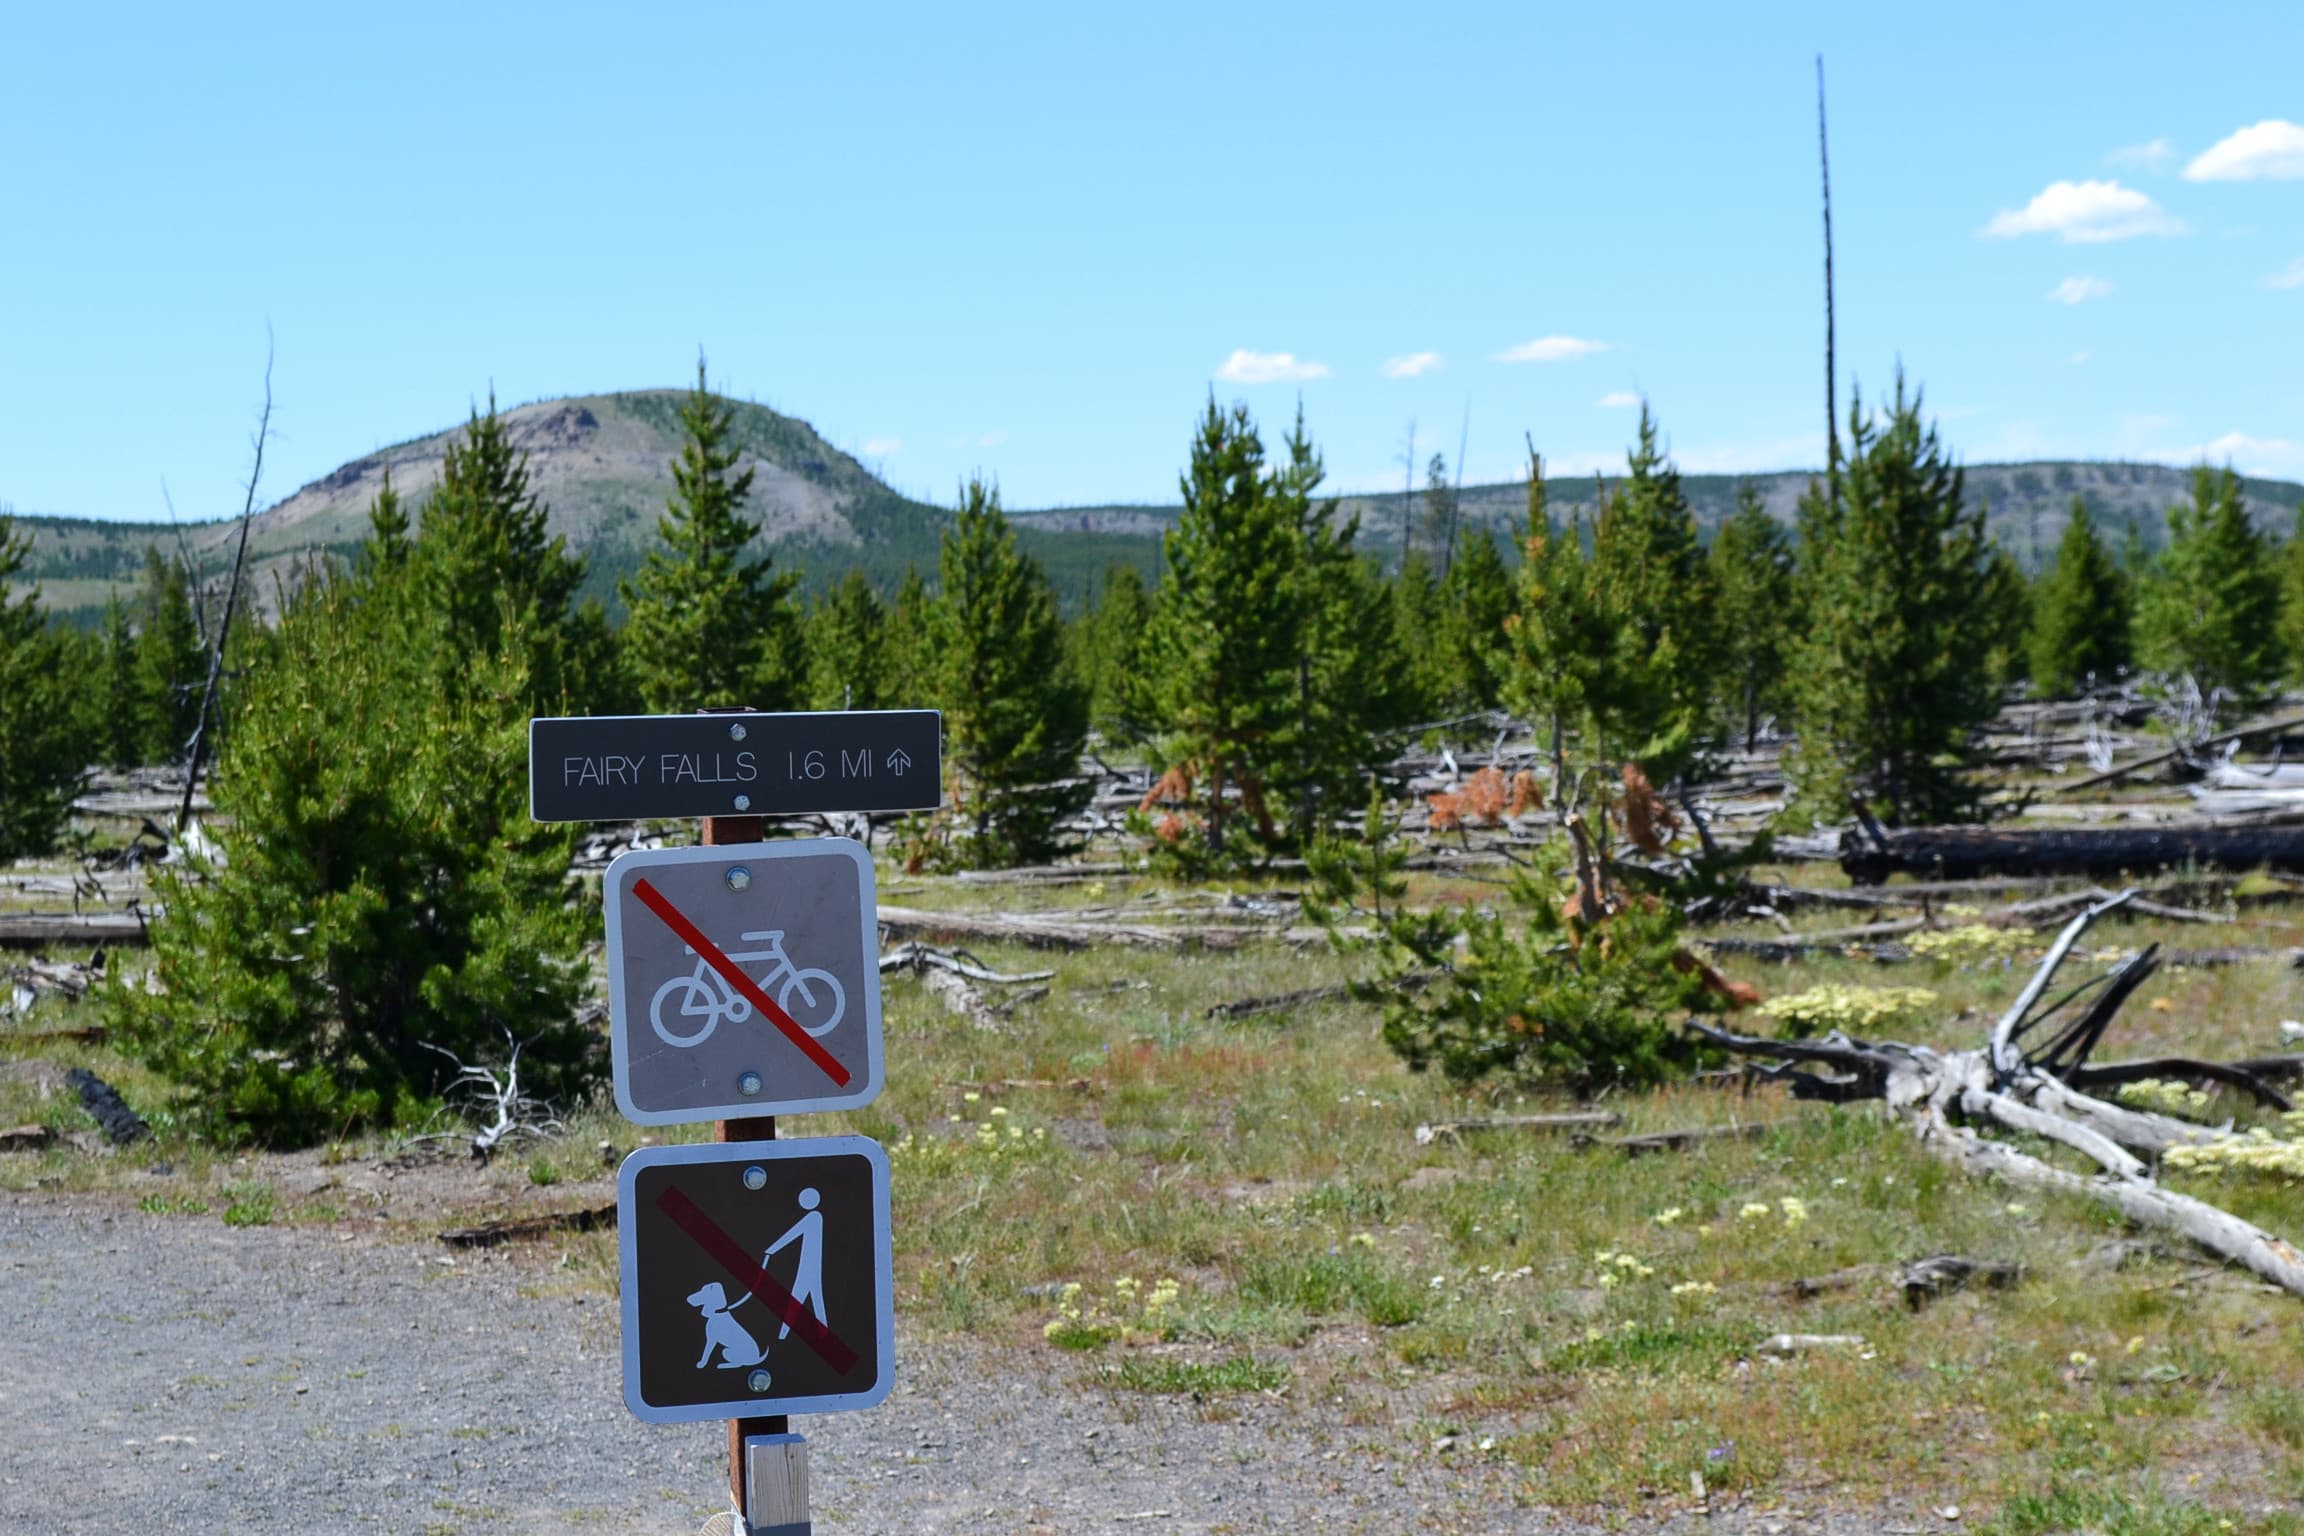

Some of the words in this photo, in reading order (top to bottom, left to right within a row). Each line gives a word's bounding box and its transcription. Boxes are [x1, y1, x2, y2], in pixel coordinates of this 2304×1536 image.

[563, 755, 646, 787] FAIRY
[660, 751, 758, 784] FALLS
[788, 750, 826, 781] 1.6
[841, 749, 873, 779] MI
